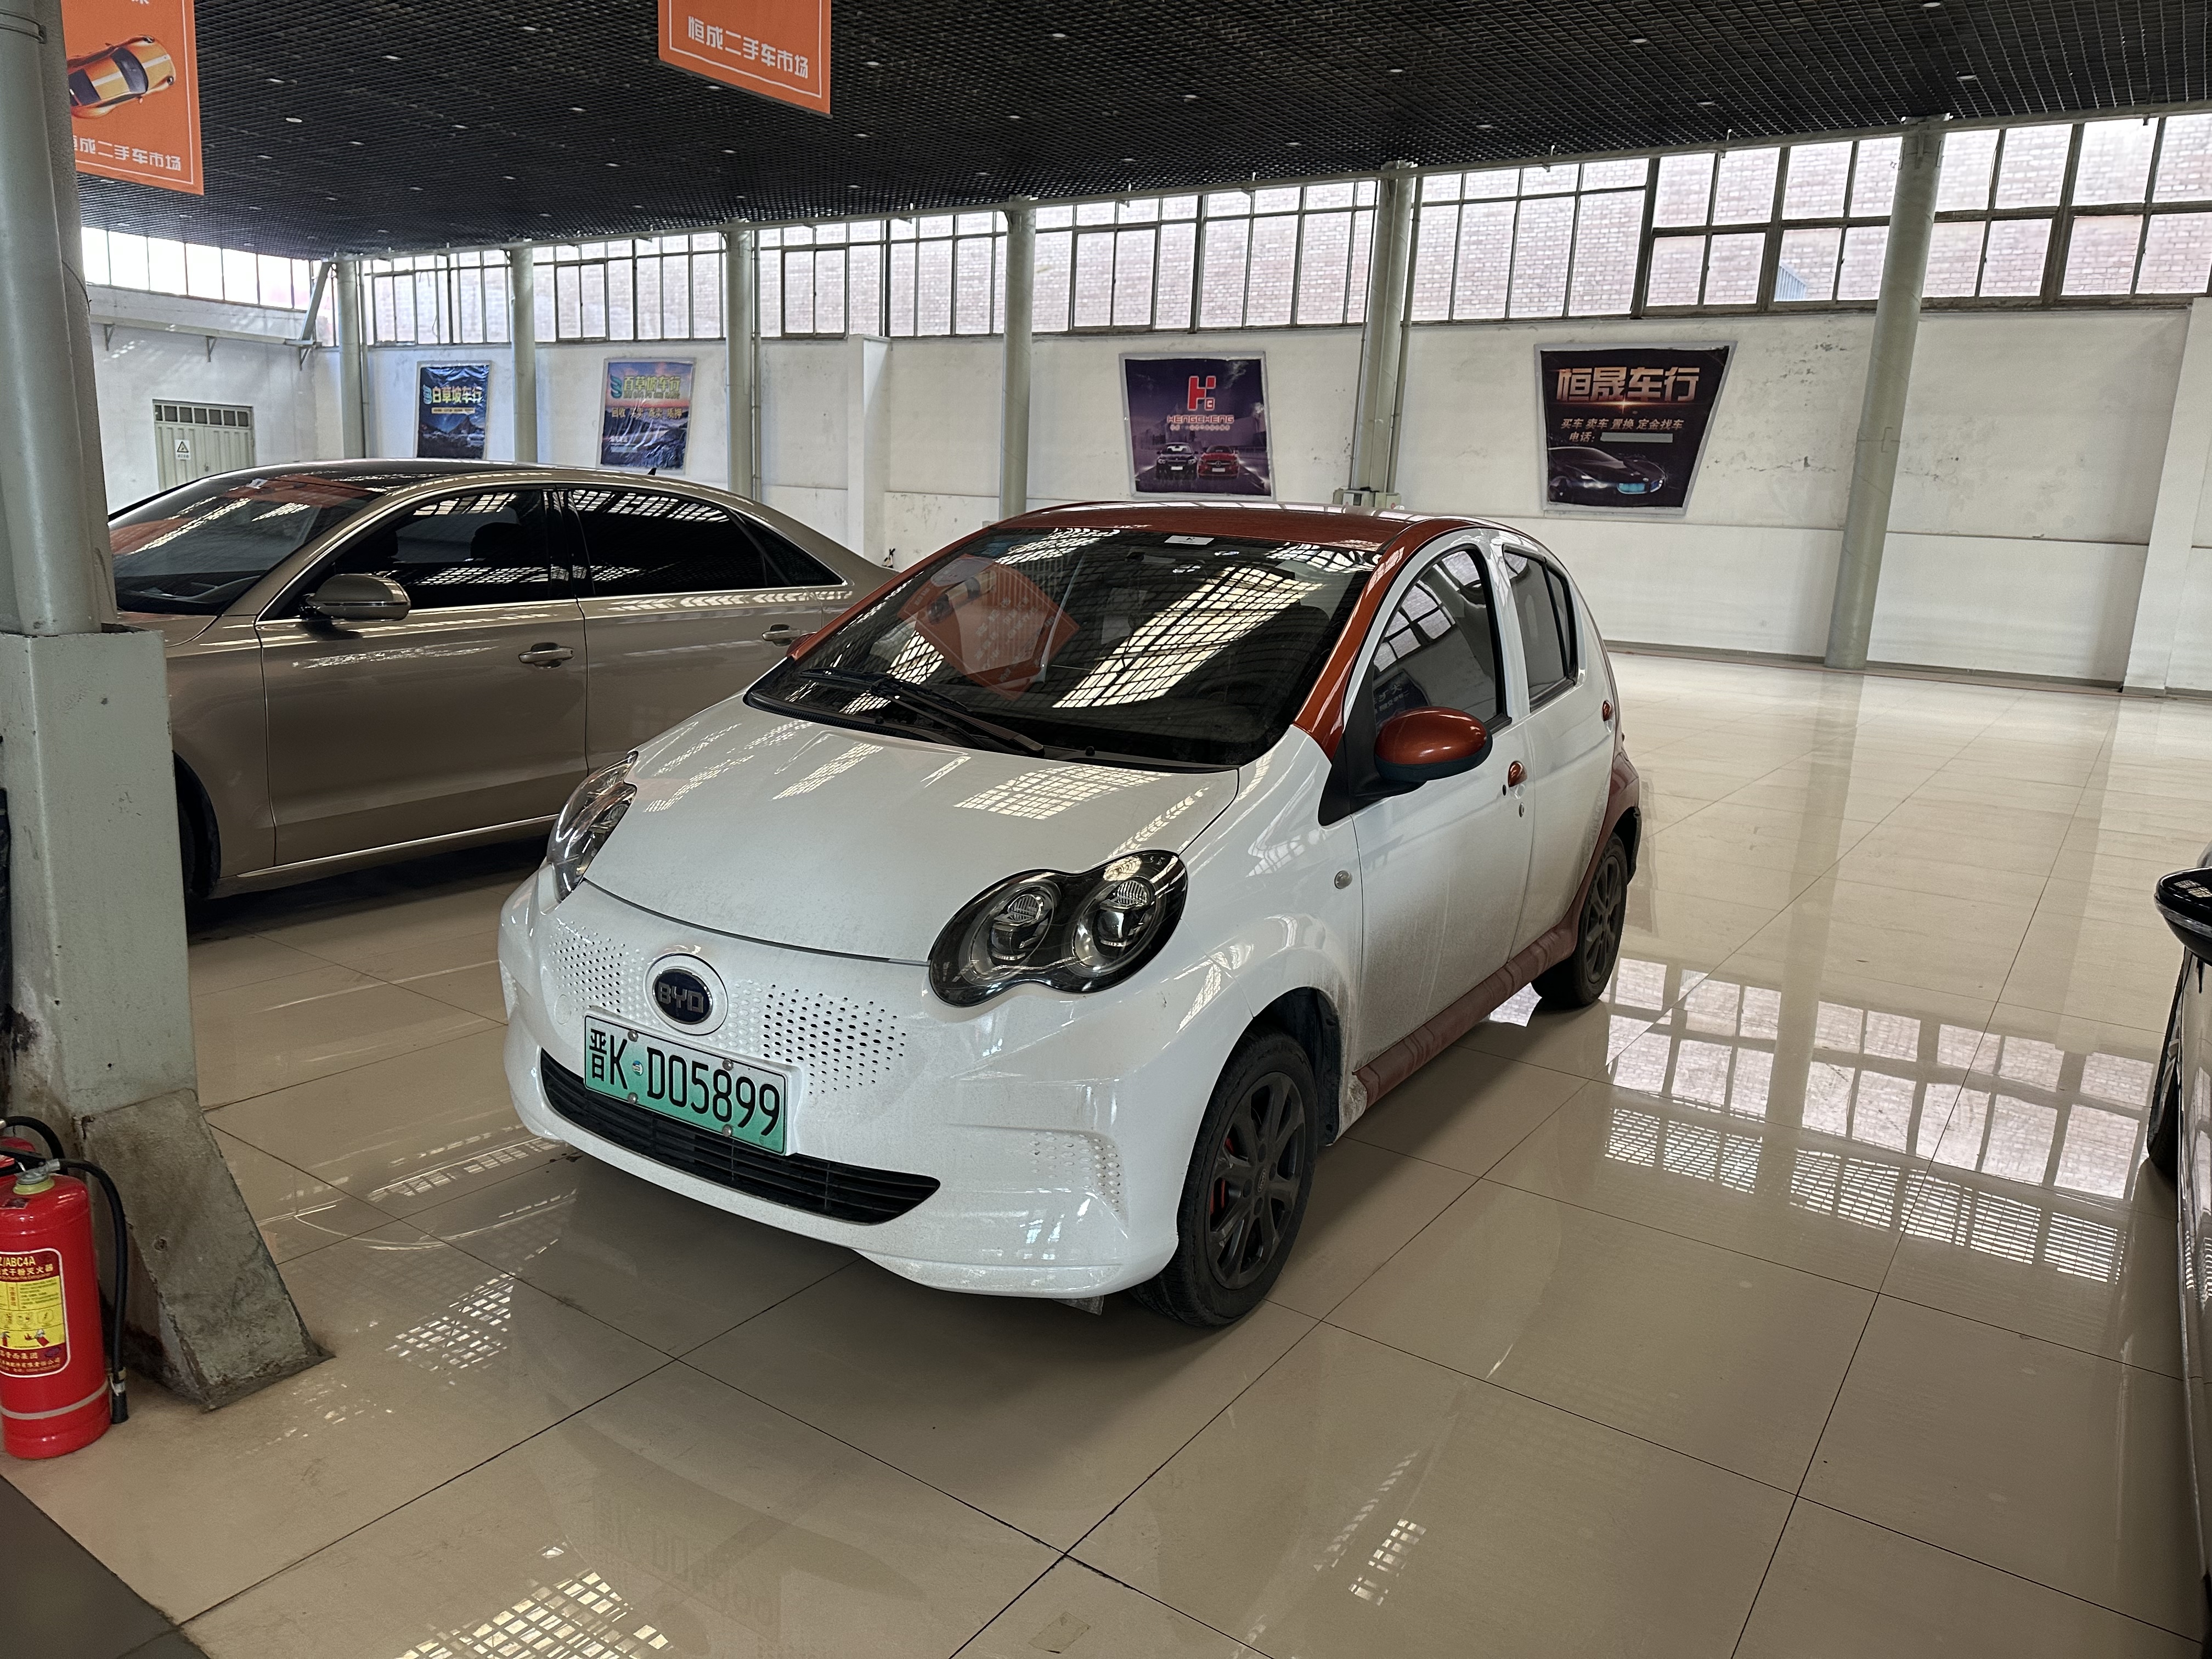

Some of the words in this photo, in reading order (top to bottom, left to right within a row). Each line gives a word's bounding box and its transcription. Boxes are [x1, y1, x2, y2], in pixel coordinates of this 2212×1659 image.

[688, 16, 808, 78] 恒成二手车市场
[1556, 366, 1700, 402] 恒晟车行
[1167, 414, 1234, 424] HENGCHENG
[1561, 418, 1584, 429] 买车
[1610, 419, 1634, 430] 置换
[658, 982, 704, 1014] BYD
[0, 1263, 53, 1276] 式干粉灭火器
